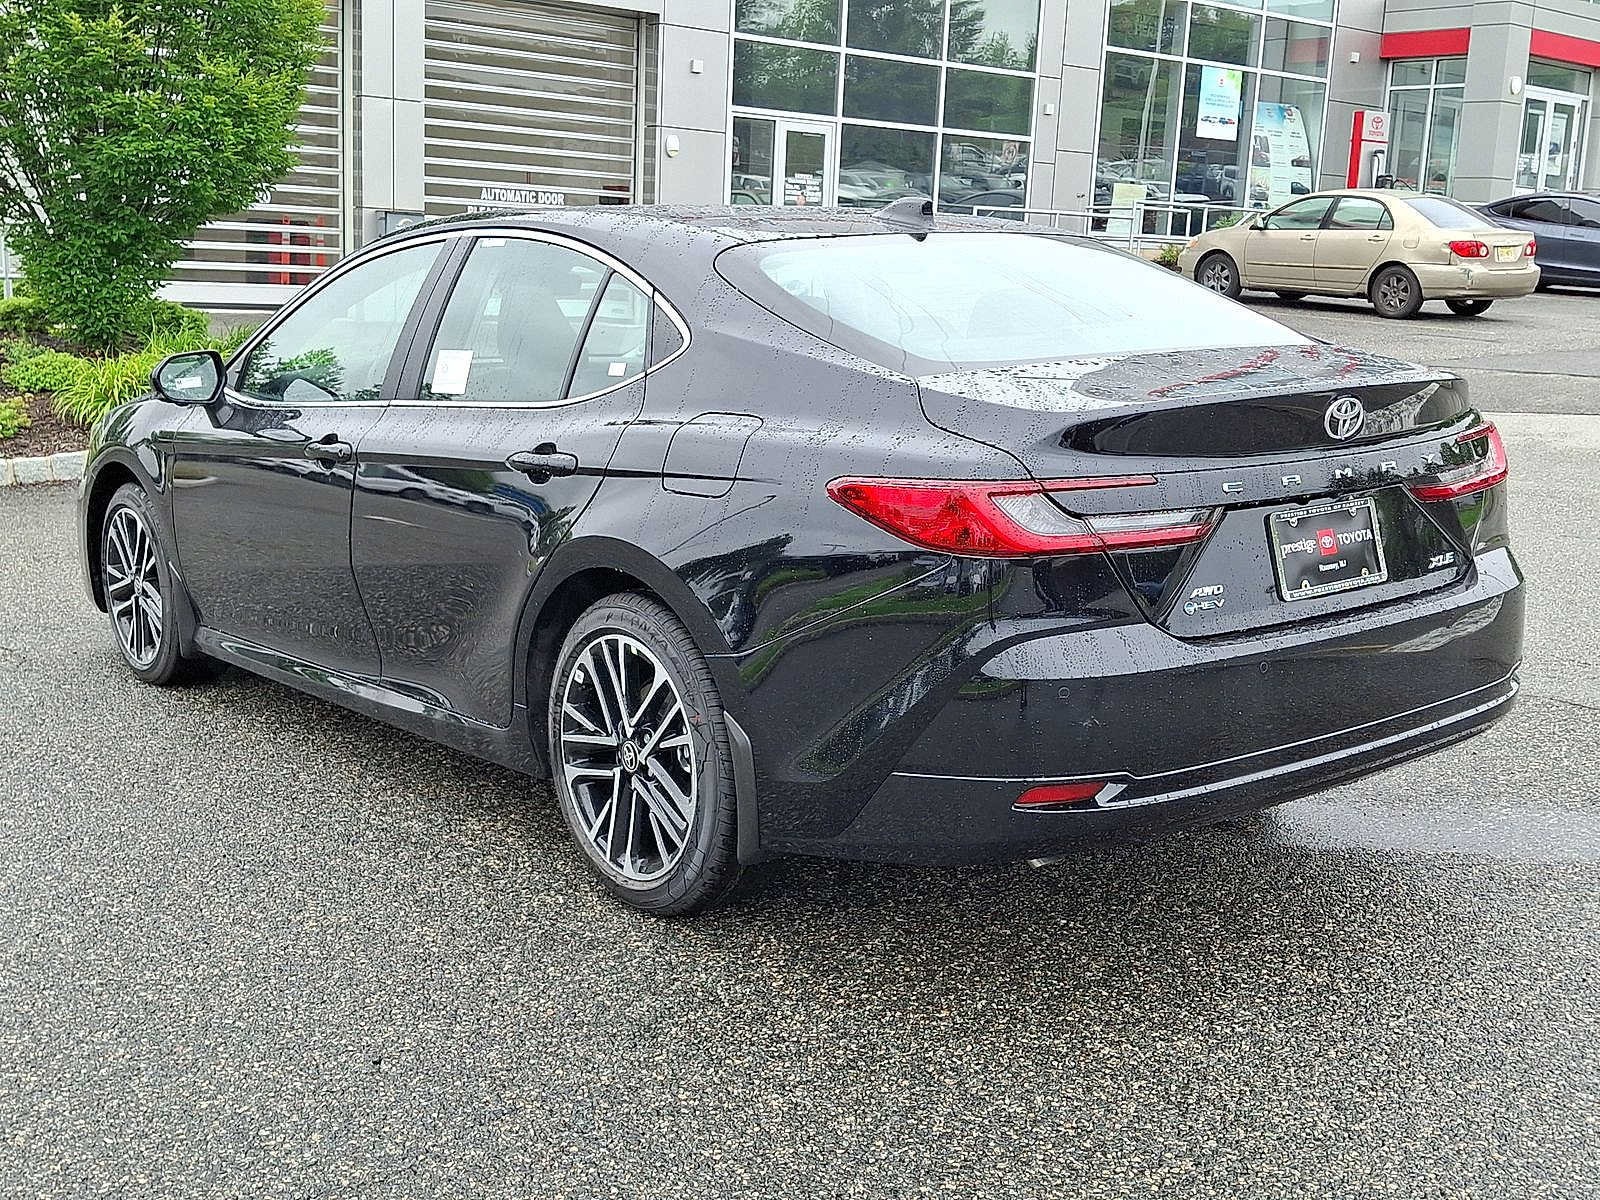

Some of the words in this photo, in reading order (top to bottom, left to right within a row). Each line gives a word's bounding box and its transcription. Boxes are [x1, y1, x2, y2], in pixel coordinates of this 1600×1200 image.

[480, 187, 537, 204] AUTOMATIC
[537, 192, 565, 206] DOOR
[1221, 453, 1443, 495] CAMRY
[1280, 537, 1318, 560] prestige
[1337, 528, 1374, 546] TOYOTA
[1428, 551, 1455, 569] XLE
[1189, 584, 1224, 599] AWD
